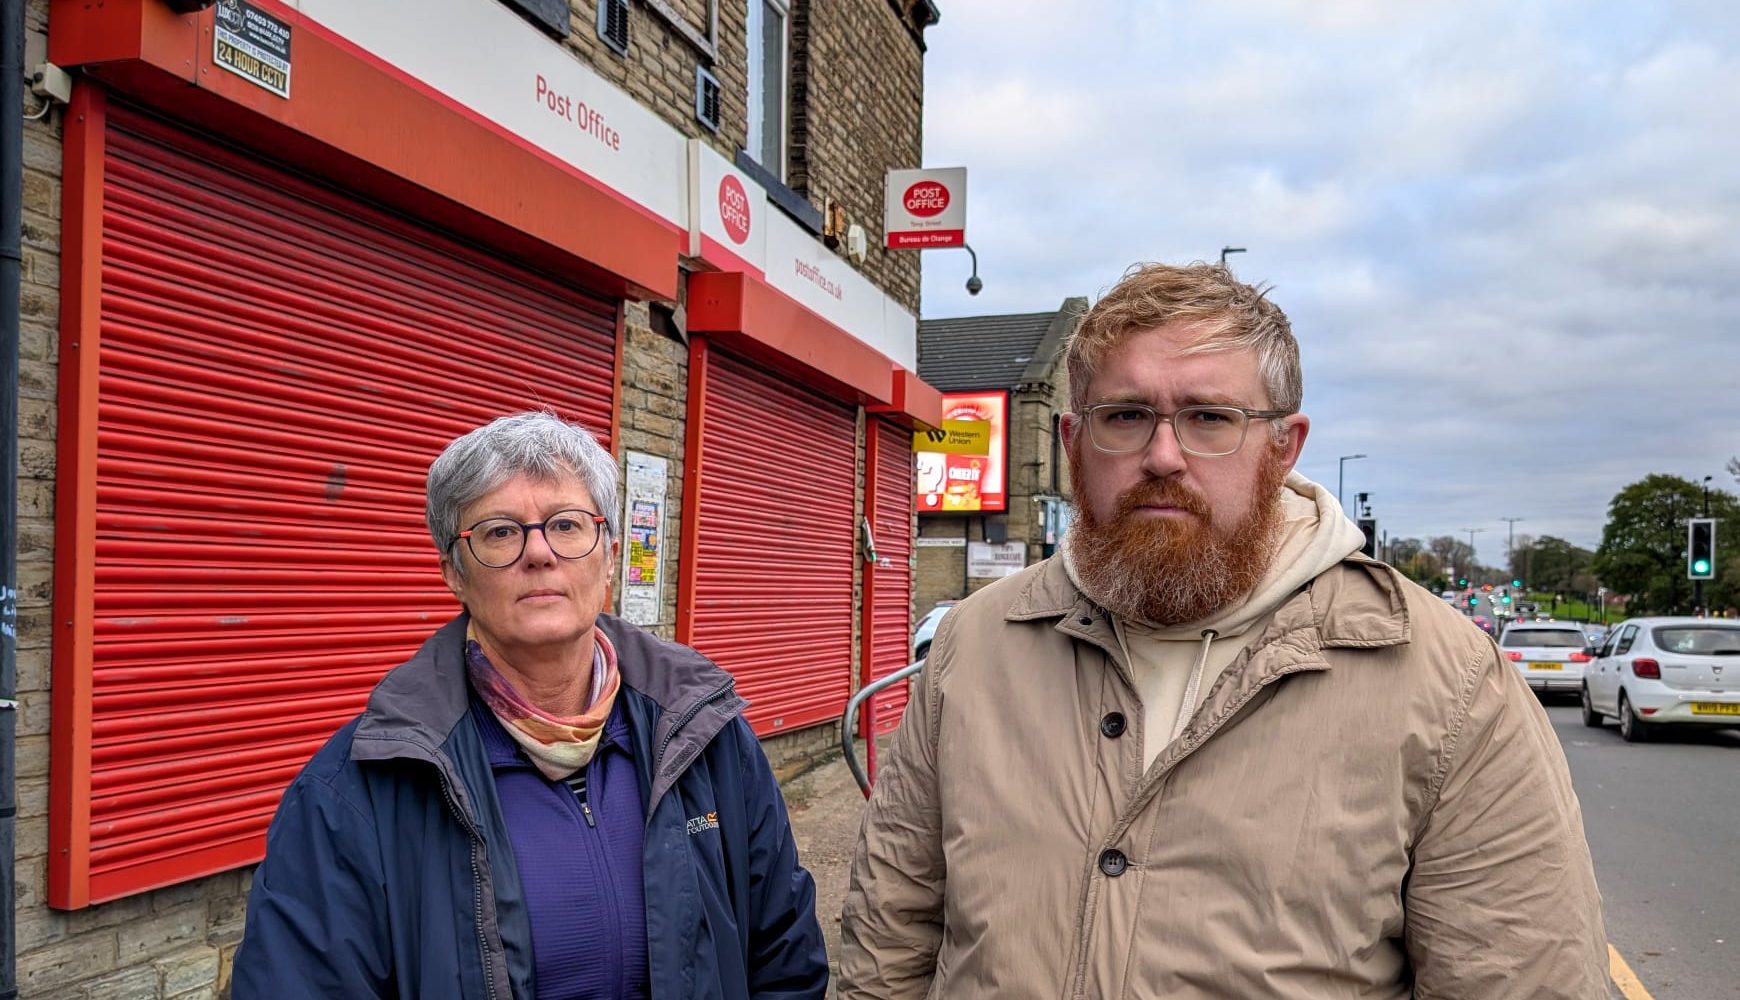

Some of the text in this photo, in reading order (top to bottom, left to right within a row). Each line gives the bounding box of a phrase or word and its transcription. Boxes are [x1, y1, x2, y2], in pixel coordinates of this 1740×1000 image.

[228, 33, 252, 54] PROPERTY
[257, 49, 281, 69] PROTECTED
[218, 43, 285, 90] 24 HOUR CCTV
[536, 74, 620, 151] Post Office
[725, 185, 745, 212] POST
[906, 198, 945, 210] OFFICE
[913, 188, 941, 199] POST
[721, 202, 748, 233] OFFICE
[899, 234, 953, 244] Bureau de Change
[794, 258, 843, 300] postoffice.co.uk
[949, 430, 981, 438] Western
[686, 815, 708, 828] ATTA
